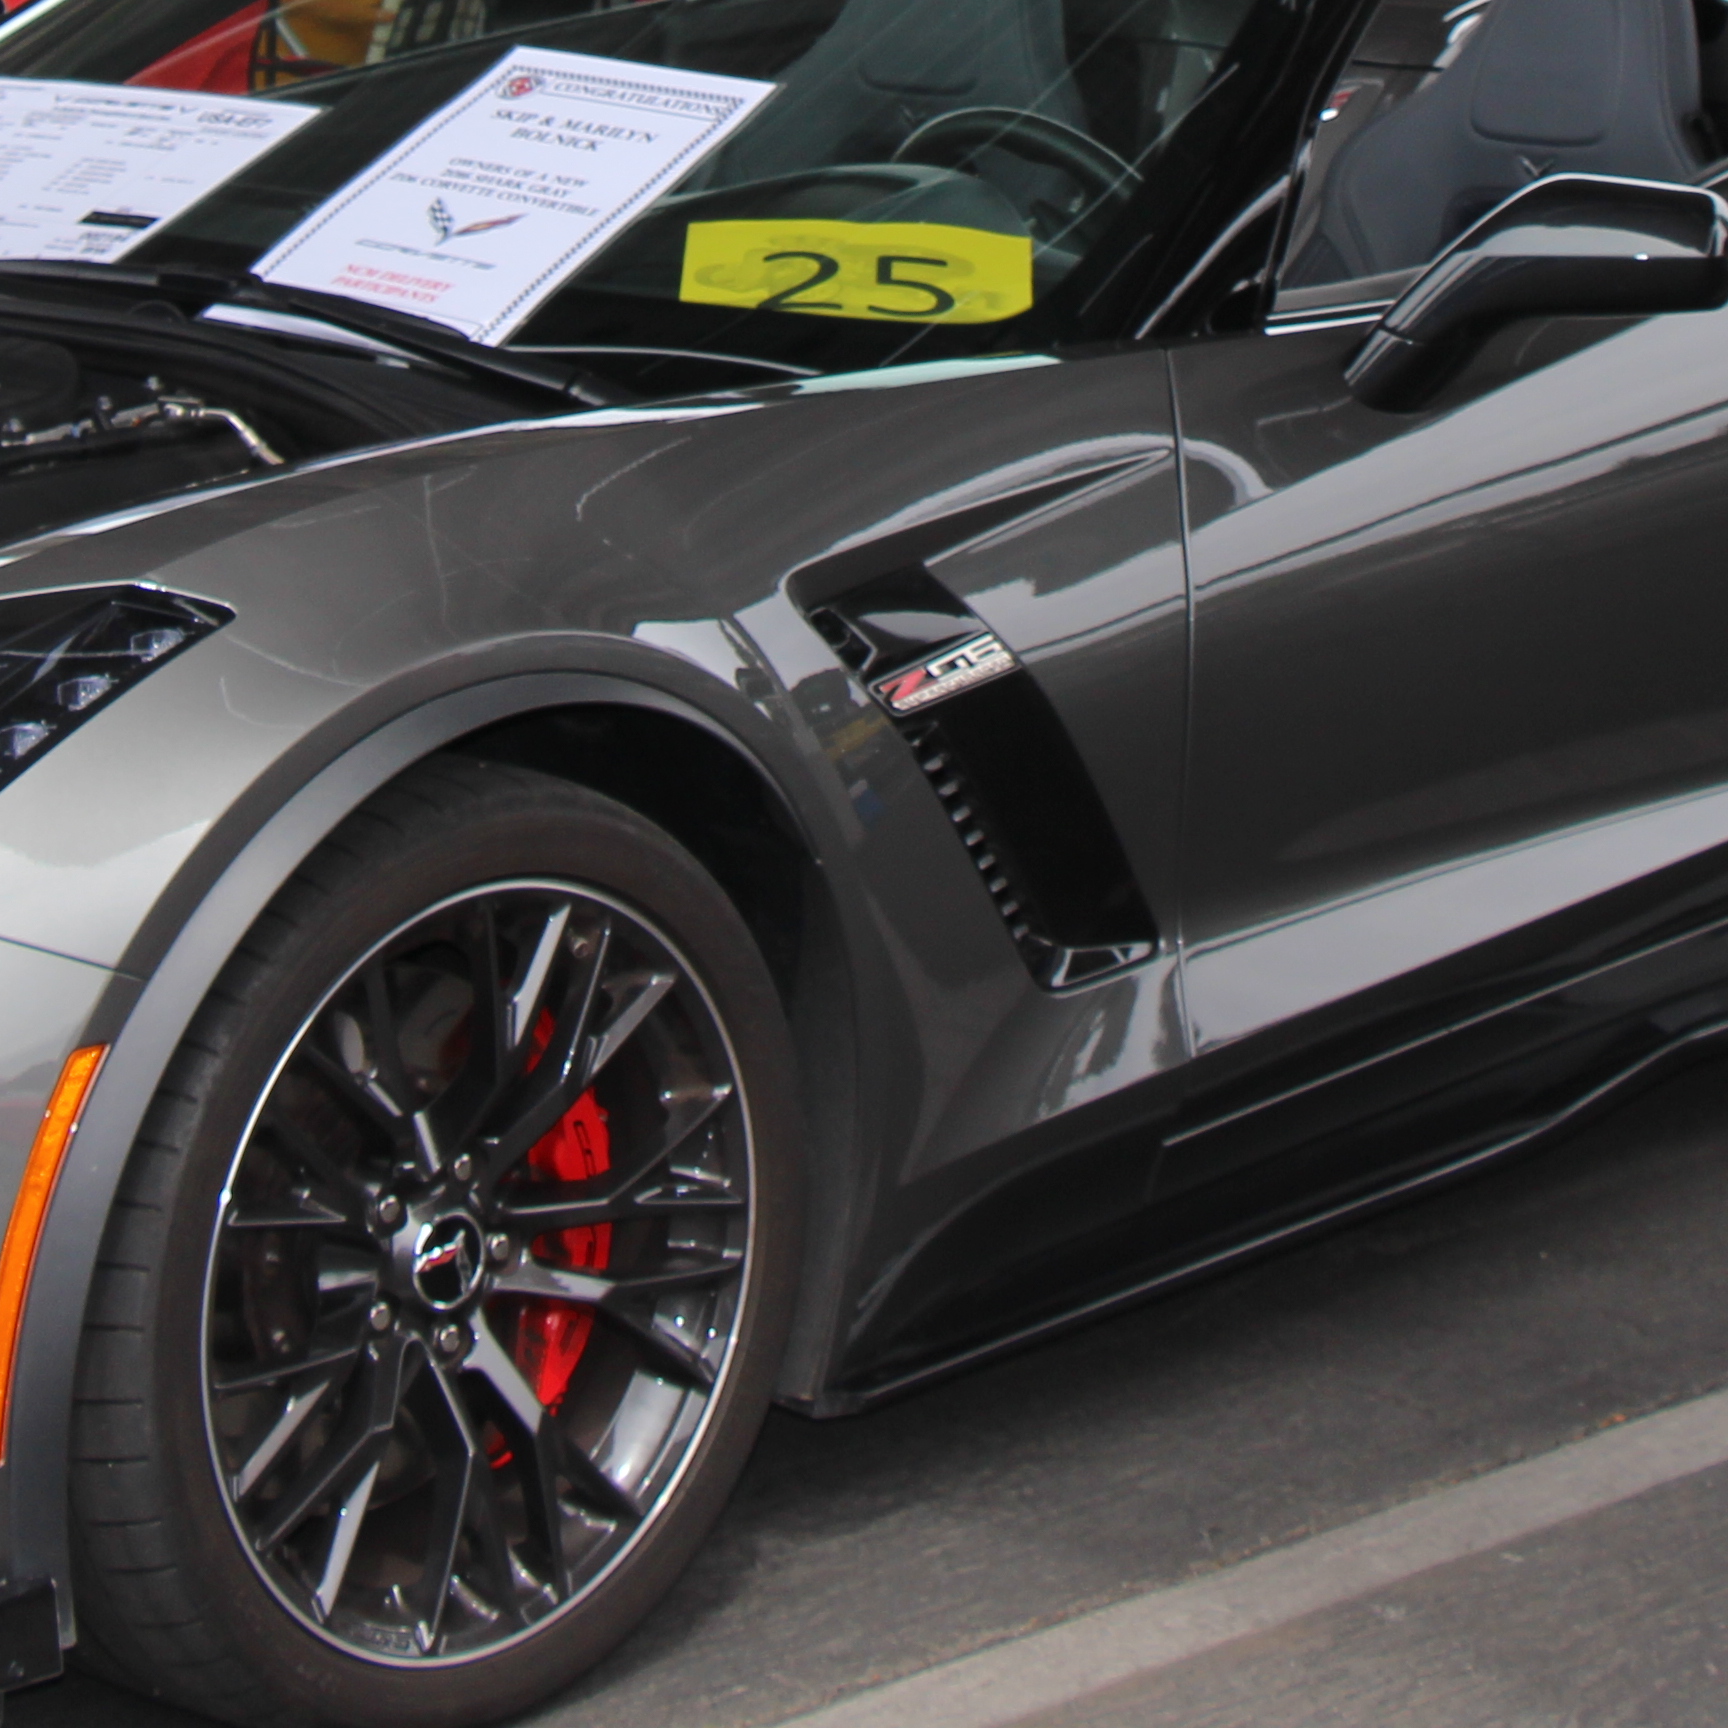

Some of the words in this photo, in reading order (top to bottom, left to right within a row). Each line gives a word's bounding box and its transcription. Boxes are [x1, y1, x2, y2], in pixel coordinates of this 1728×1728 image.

[491, 108, 538, 123] SKIP
[538, 115, 556, 127] &
[563, 119, 659, 144] MARILYN
[527, 183, 571, 199] GRAY
[755, 250, 956, 319] 25
